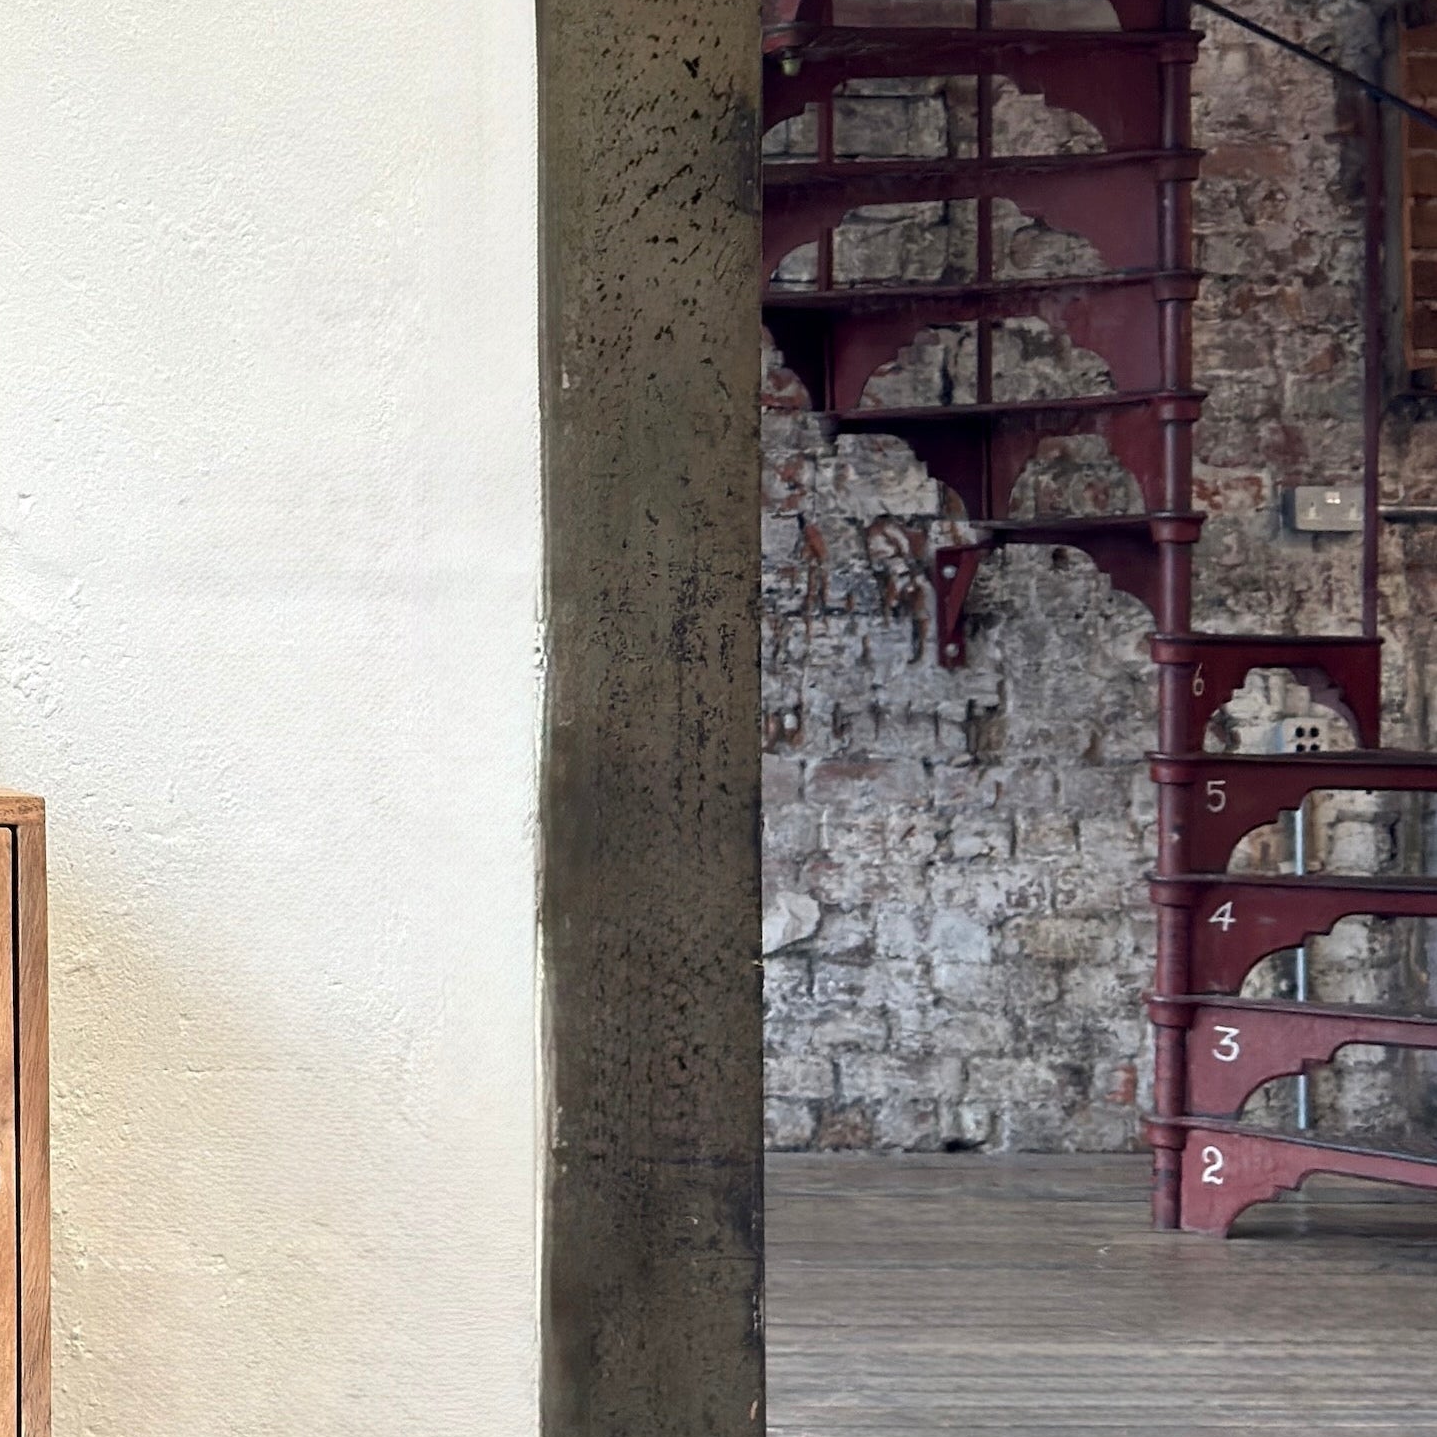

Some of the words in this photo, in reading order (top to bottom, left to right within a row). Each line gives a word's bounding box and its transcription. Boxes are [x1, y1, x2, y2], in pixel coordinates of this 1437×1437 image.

[1192, 662, 1204, 696] 6
[1206, 780, 1226, 813] 5
[1209, 901, 1236, 931] 4
[1212, 1025, 1240, 1061] 3
[1201, 1145, 1224, 1185] 2
